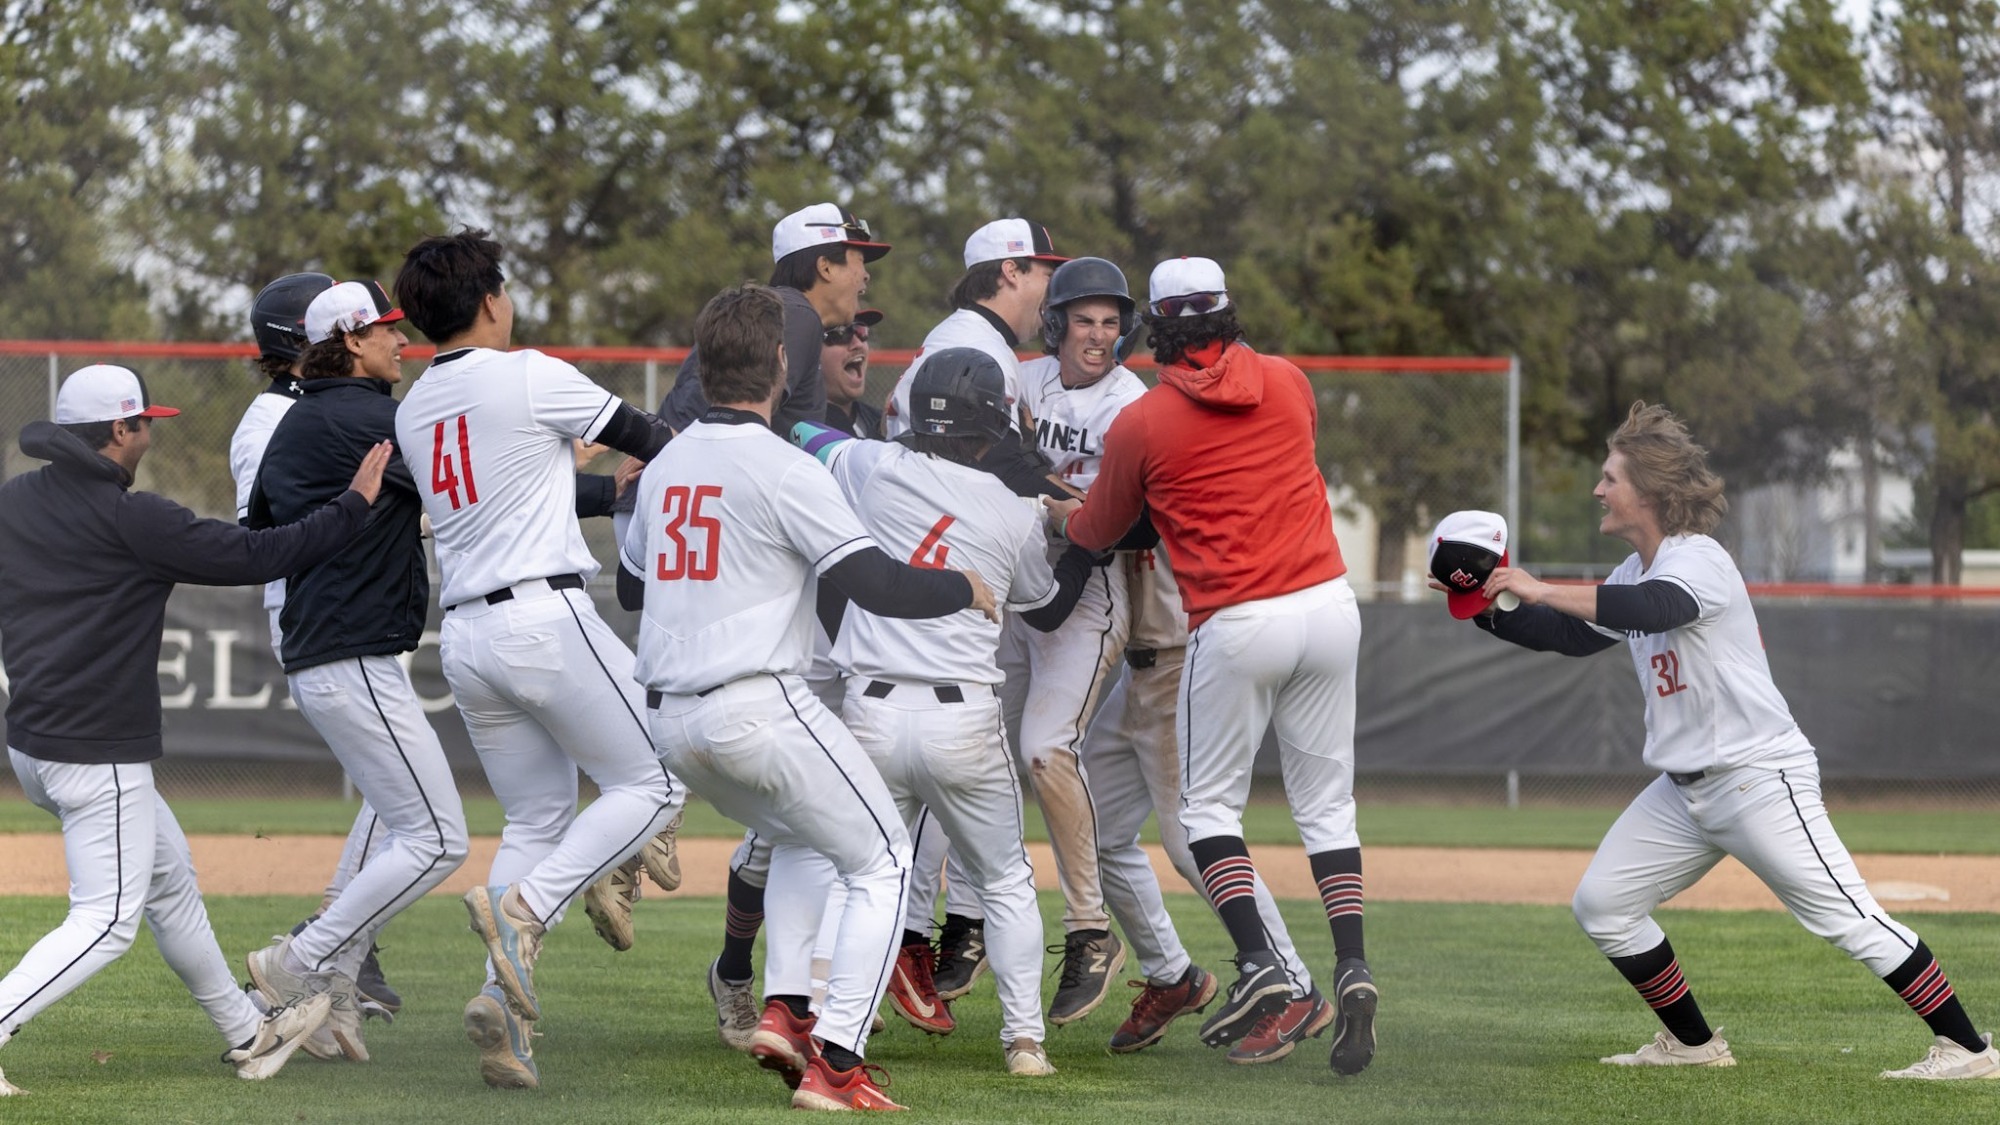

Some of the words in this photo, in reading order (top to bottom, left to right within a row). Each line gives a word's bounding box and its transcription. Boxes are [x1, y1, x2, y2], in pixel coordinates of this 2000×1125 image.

[432, 413, 479, 511] 41
[657, 485, 723, 580] 35
[909, 514, 956, 570] 4
[1650, 649, 1688, 698] 32
